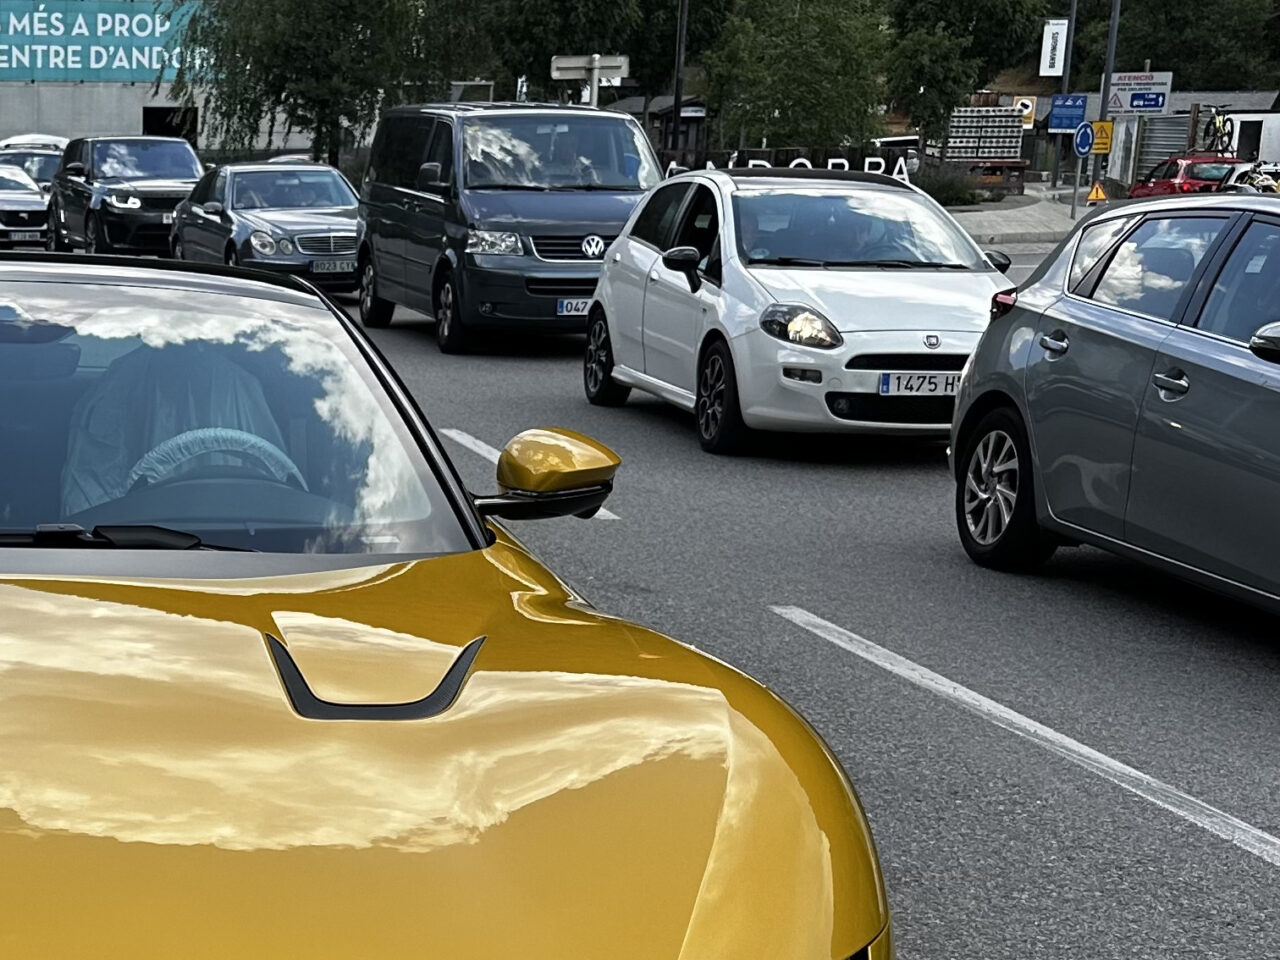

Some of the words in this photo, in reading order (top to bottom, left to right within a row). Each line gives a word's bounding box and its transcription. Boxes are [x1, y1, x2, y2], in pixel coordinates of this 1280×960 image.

[8, 4, 65, 36] MÉS
[71, 12, 89, 37] A
[96, 13, 171, 38] PROP
[895, 375, 938, 393] 1475
